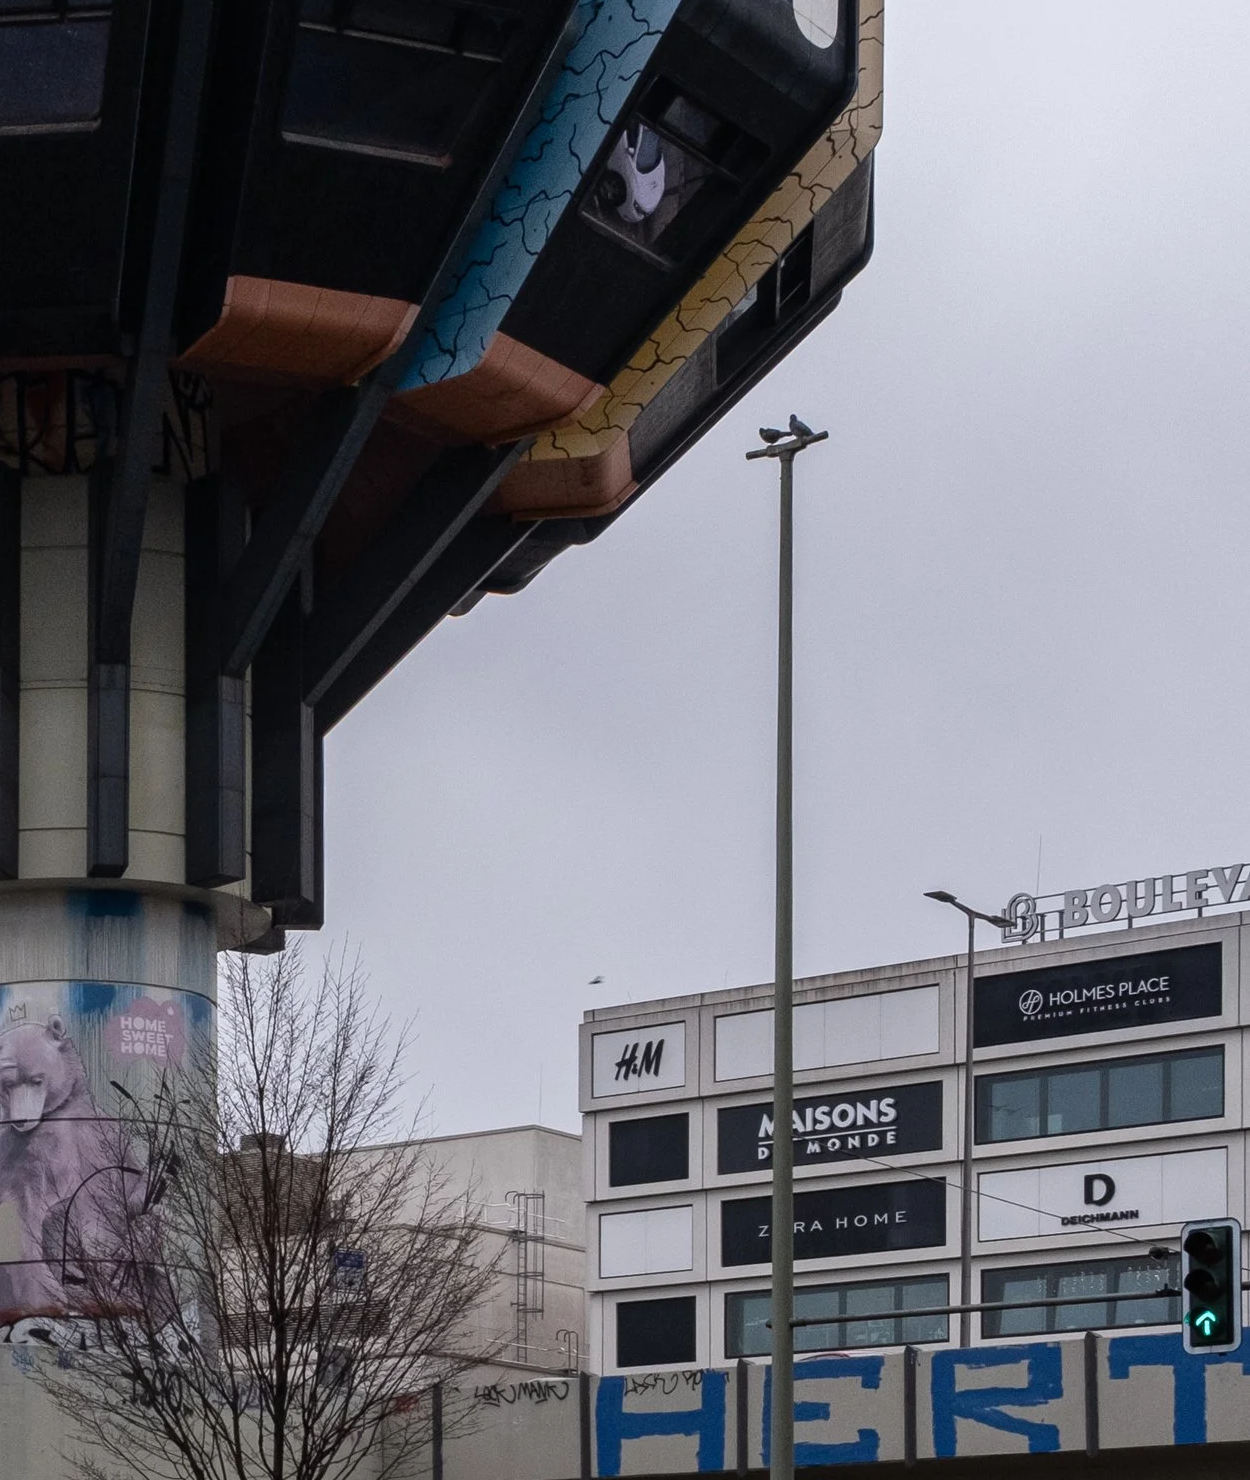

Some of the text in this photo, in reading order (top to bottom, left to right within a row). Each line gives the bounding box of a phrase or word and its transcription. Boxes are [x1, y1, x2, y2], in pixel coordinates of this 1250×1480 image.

[1049, 976, 1170, 1006] HOLMES PLACE
[1079, 1002, 1127, 1014] FITNESS
[1134, 995, 1171, 1007] CLUBS
[120, 1015, 166, 1033] HOME
[122, 1029, 174, 1045] SWEET
[120, 1041, 167, 1057] HOME
[614, 1038, 665, 1081] H&M
[806, 1131, 897, 1155] MONDE
[1084, 1173, 1116, 1206] D
[758, 1210, 907, 1237] ZRA HOME
[1060, 1209, 1140, 1227] DEICHMANN
